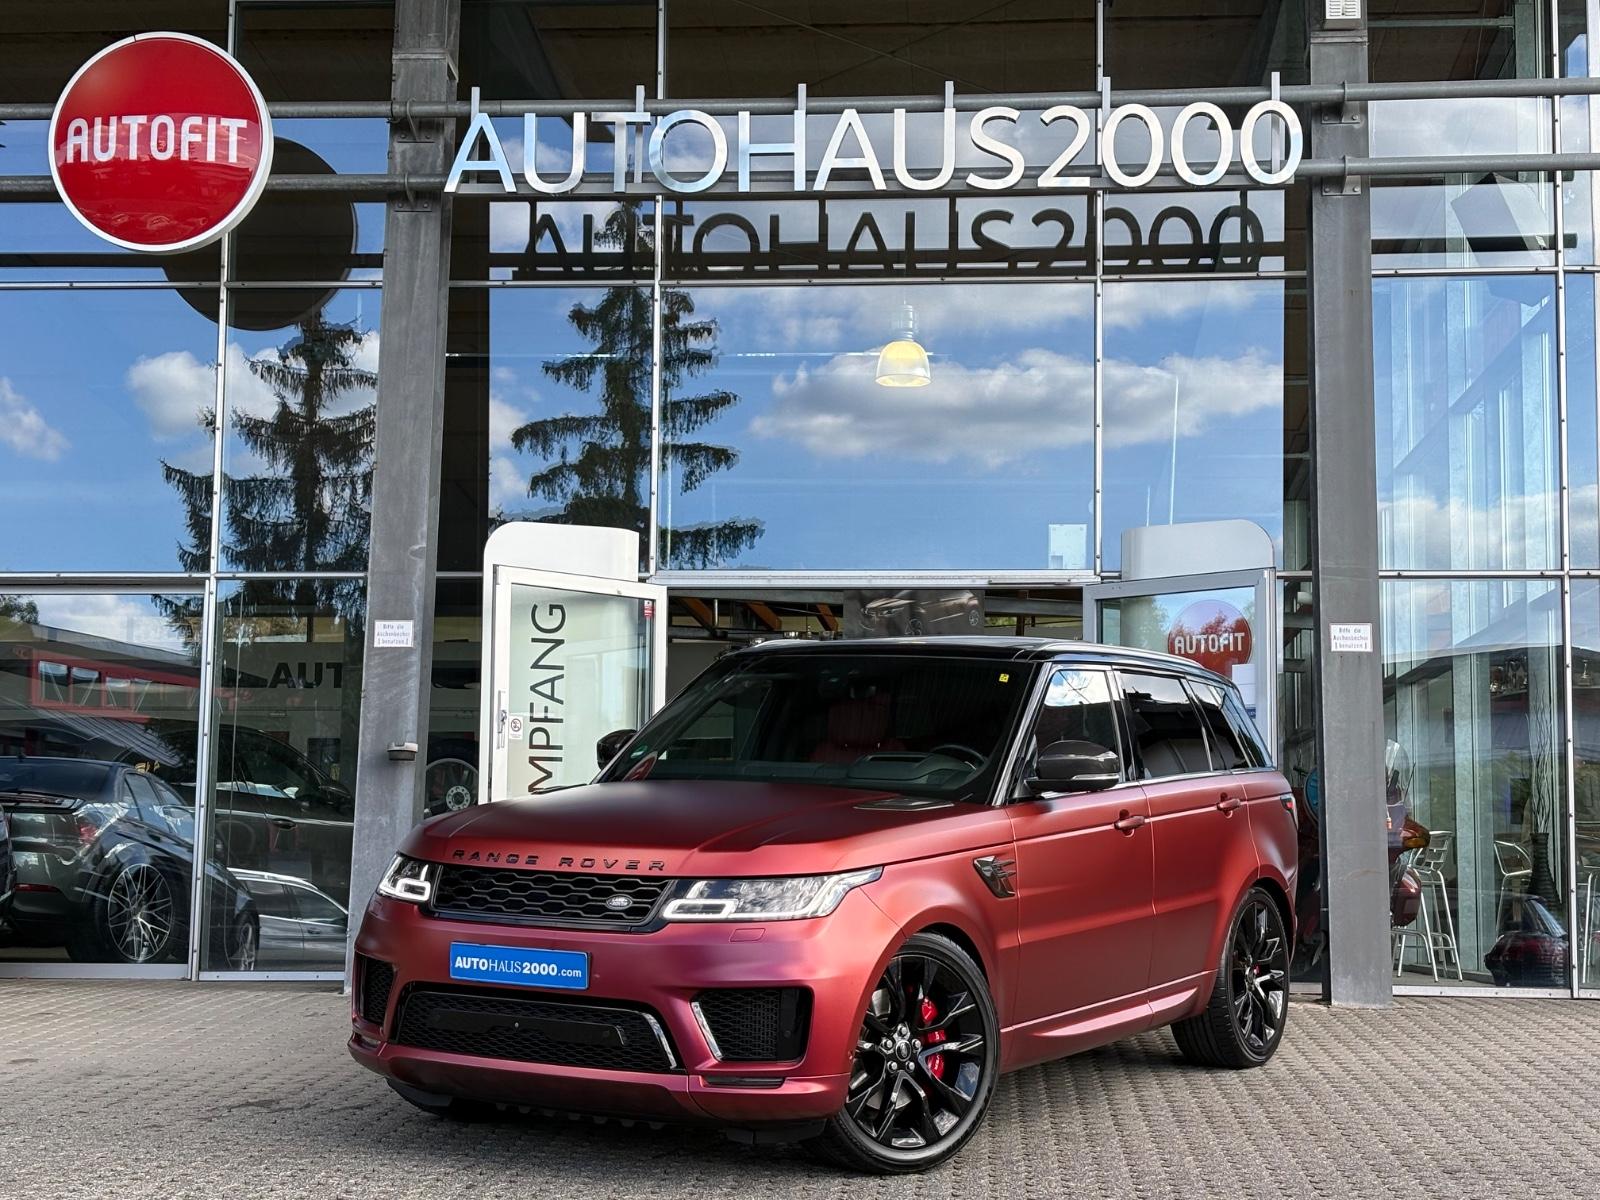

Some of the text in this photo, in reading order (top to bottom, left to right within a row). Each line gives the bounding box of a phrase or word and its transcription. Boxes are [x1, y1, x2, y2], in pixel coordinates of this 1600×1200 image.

[66, 115, 247, 163] AUTOFIT
[444, 100, 1303, 194] AUTOHAUS2000
[1174, 632, 1245, 655] AUTOFIT
[267, 662, 342, 689] AUT
[528, 604, 566, 793] MPFANG
[452, 849, 665, 871] RANGE ROVER
[454, 955, 582, 979] AUTOHAUS2000.com
